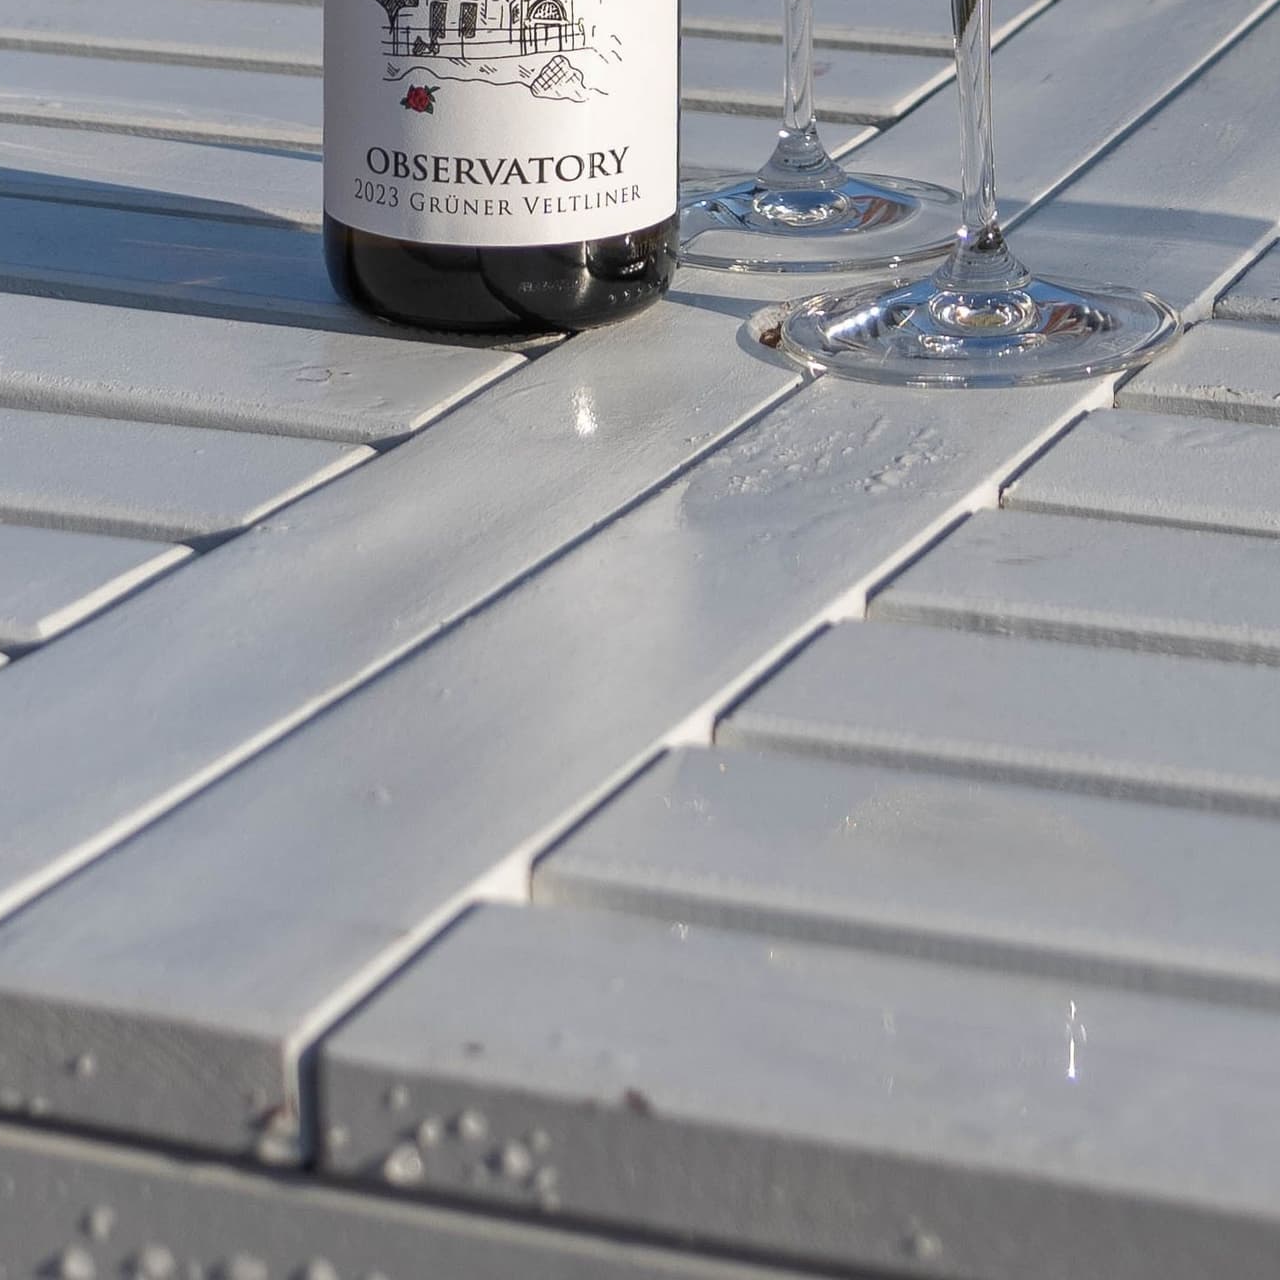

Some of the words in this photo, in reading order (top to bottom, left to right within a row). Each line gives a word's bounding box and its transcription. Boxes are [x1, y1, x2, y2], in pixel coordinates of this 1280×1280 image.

[366, 146, 630, 185] OBSERVATORY
[354, 178, 399, 208] 2023
[410, 192, 513, 216] GRÜNER
[523, 184, 641, 215] VELTLINER
